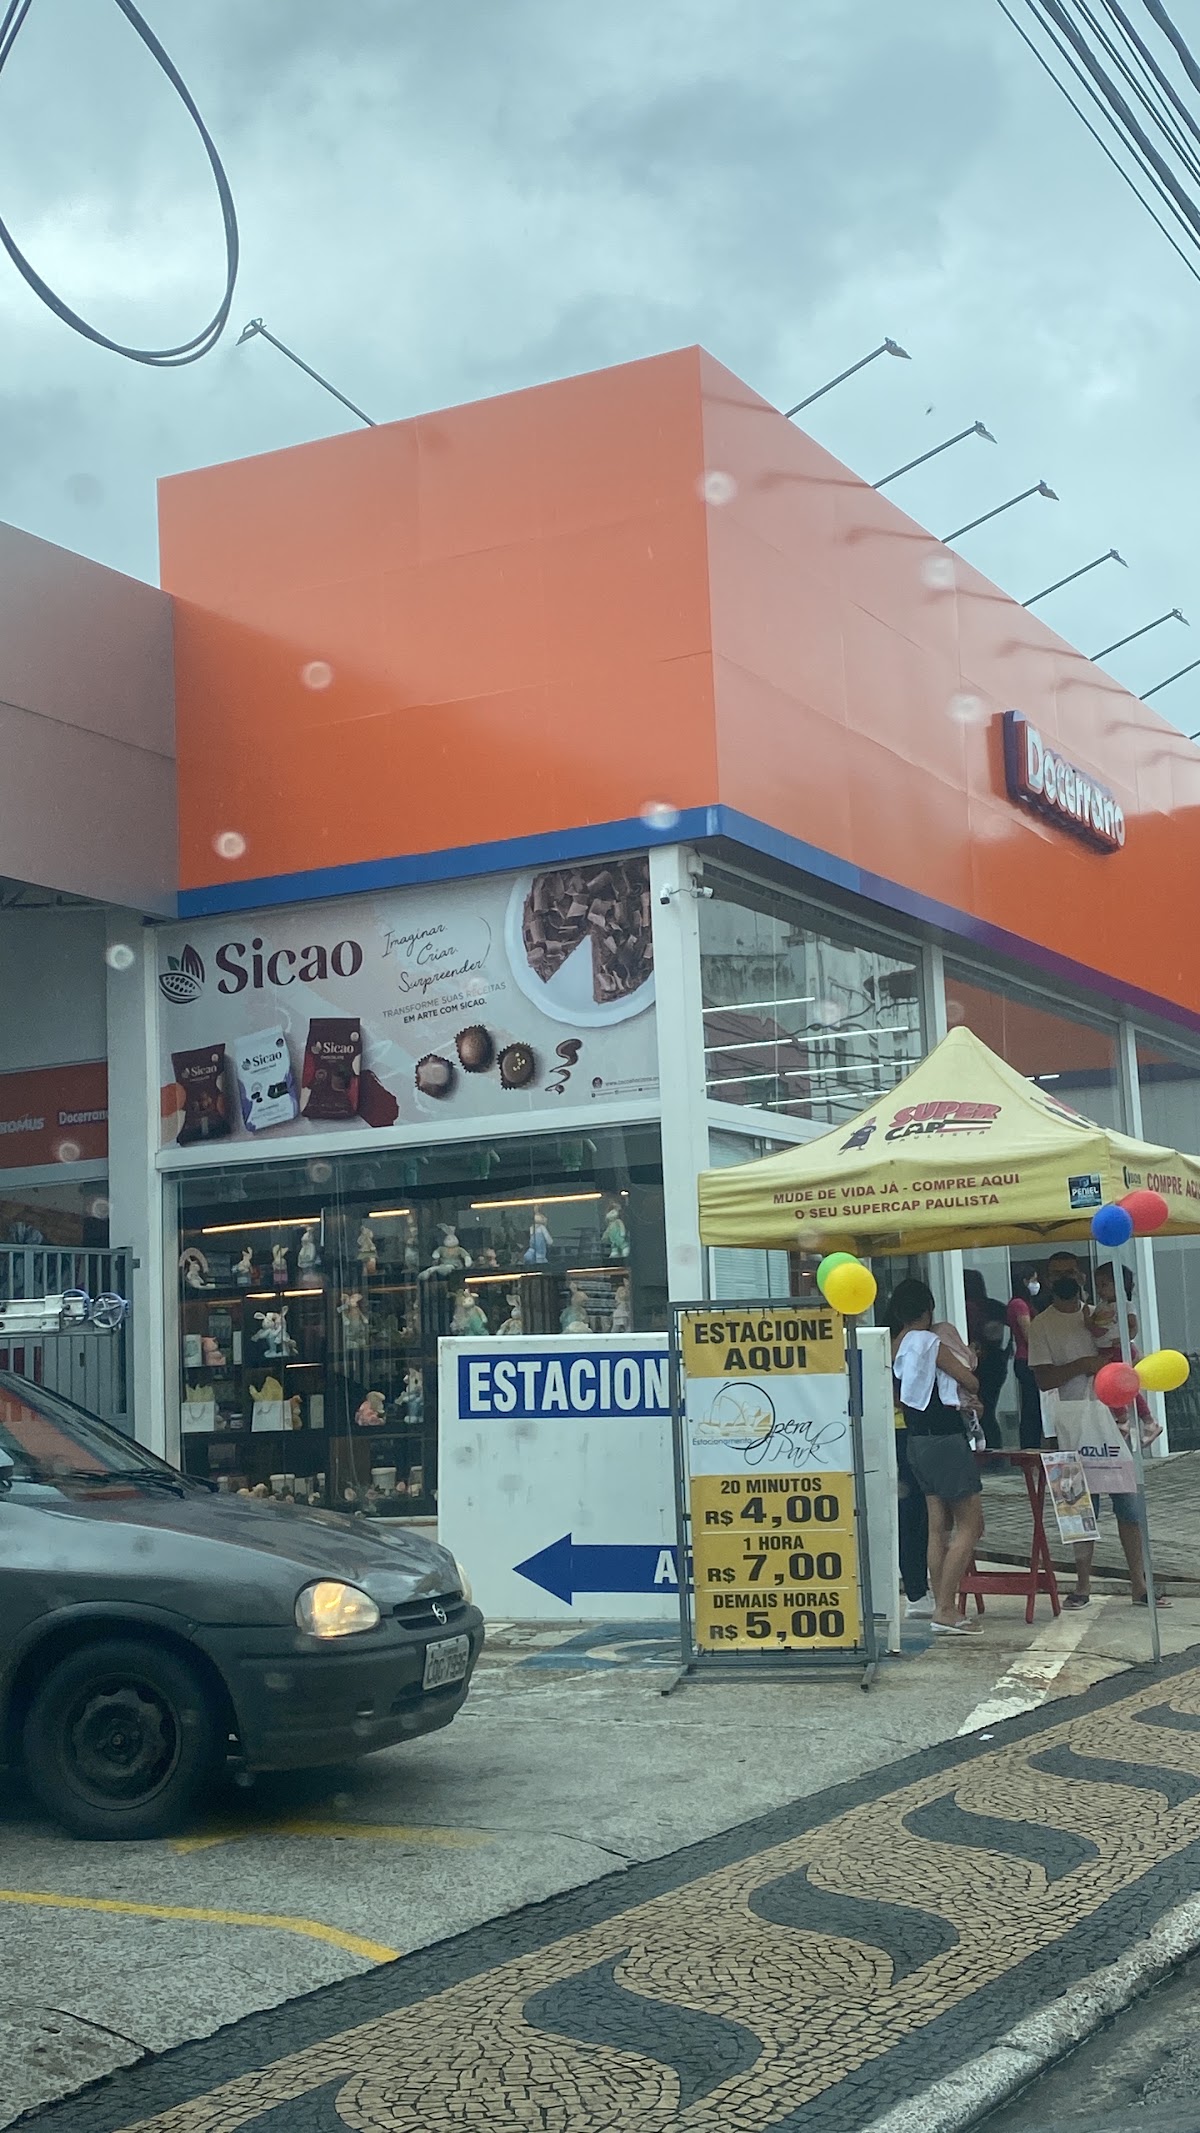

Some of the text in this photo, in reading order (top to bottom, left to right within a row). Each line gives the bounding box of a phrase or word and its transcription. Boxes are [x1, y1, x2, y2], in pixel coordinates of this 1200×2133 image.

[1027, 724, 1126, 847] Docerrano
[215, 937, 363, 994] Sicao
[382, 982, 507, 1019] TRANSFORME SUAS RECEITAS
[403, 1013, 416, 1024] EM
[417, 1009, 439, 1021] ARTE
[439, 1004, 459, 1015] COM
[252, 1050, 283, 1067] Sicao
[323, 1042, 355, 1054] Sicao
[191, 1065, 218, 1078] Sicao
[889, 1101, 1002, 1127] SUPER
[885, 1121, 946, 1141] CAP
[773, 1190, 813, 1204] MUDE
[818, 1188, 836, 1200] DE
[841, 1185, 876, 1198] VIDA
[880, 1181, 899, 1194] JÁ
[912, 1177, 976, 1192] COMPRE
[981, 1173, 1020, 1188] AQUI
[1071, 1186, 1100, 1197] PENIEL
[1146, 1172, 1183, 1196] COMPRE
[795, 1194, 1000, 1220] O SEU SUPERCAP PAULISTA
[694, 1319, 834, 1344] ESTACIONE
[723, 1345, 807, 1372] AQUI
[468, 1357, 671, 1413] ESTACION
[692, 1437, 753, 1446] Estacionamento
[721, 1477, 822, 1494] 20 MINUTOS
[705, 1494, 840, 1528] R$ 4,00
[743, 1535, 804, 1551] 1 HORA
[707, 1552, 842, 1586] R$ 7,00
[713, 1592, 840, 1609] DEMAIS HORAS
[709, 1609, 845, 1643] R$ 5,00
